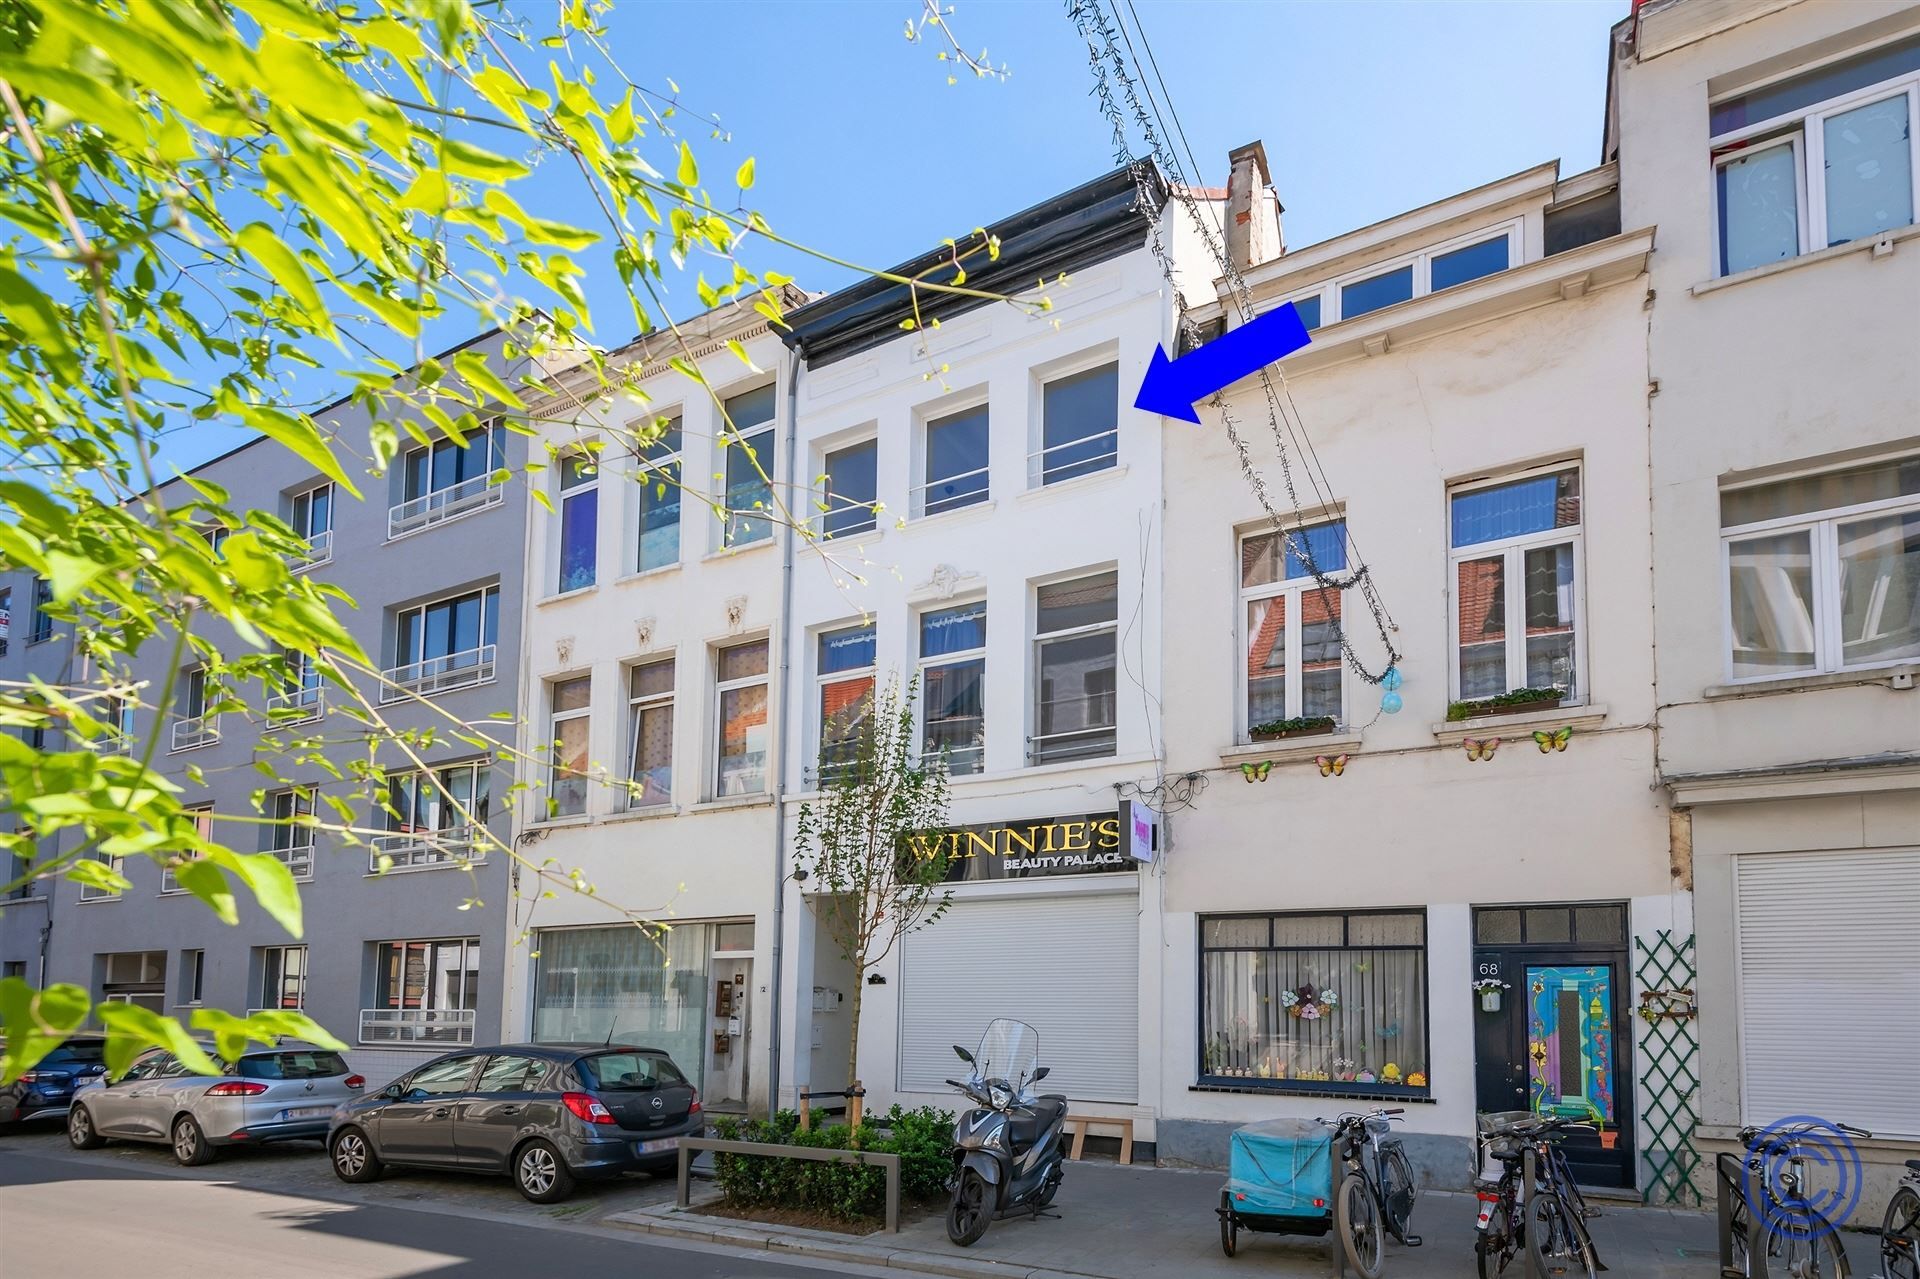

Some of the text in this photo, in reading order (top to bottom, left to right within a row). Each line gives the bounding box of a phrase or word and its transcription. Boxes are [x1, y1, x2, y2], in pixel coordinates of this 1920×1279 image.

[907, 819, 1120, 862] WINNIE'S
[1003, 852, 1123, 870] BEAUTY PALACE
[1480, 963, 1498, 975] 68
